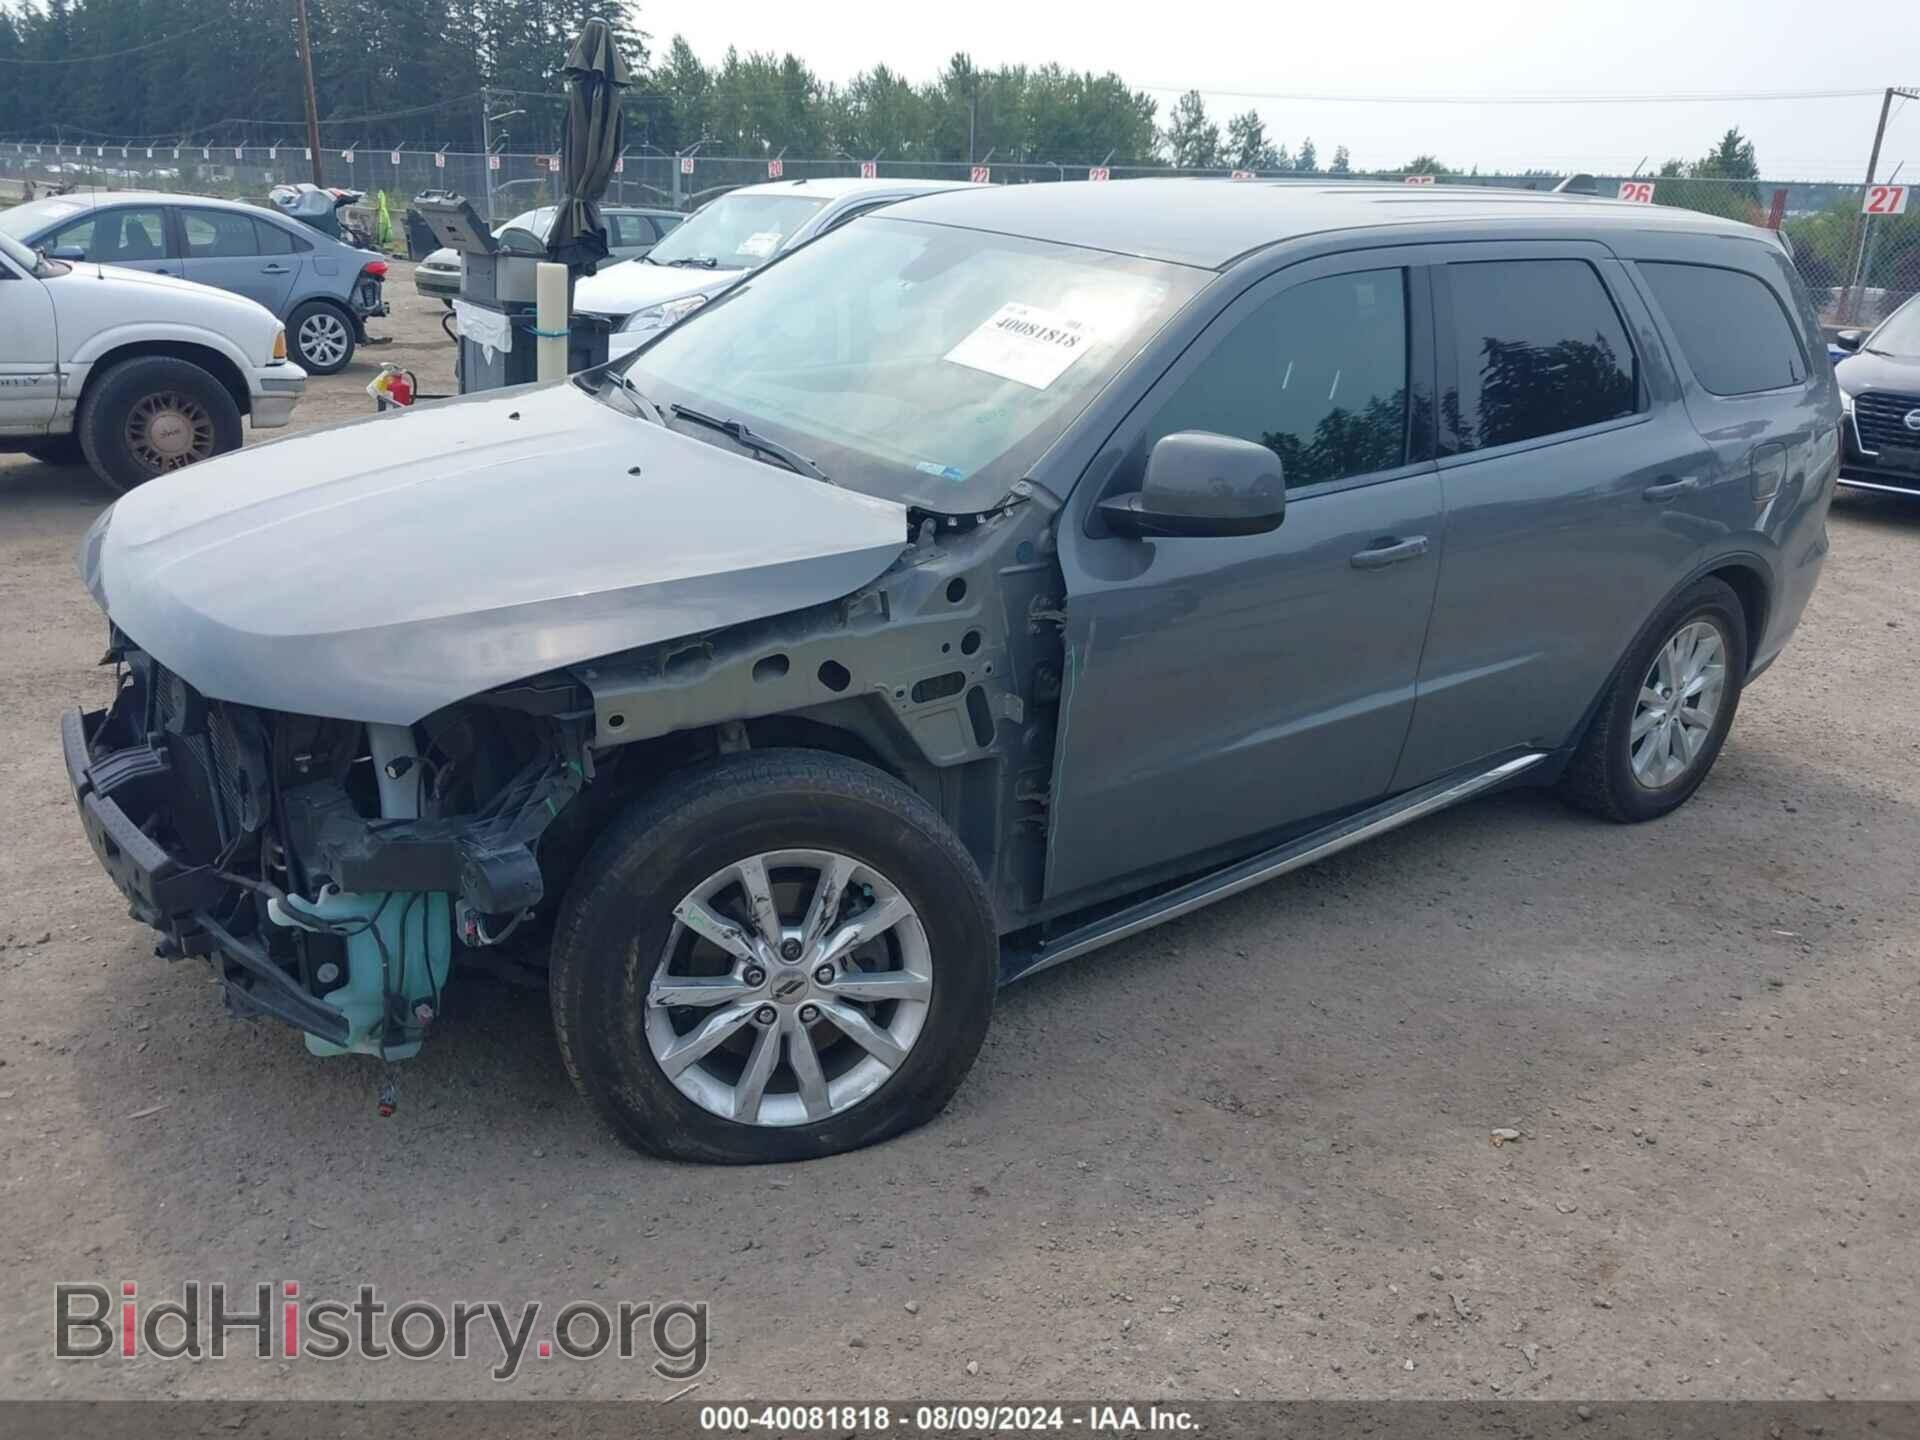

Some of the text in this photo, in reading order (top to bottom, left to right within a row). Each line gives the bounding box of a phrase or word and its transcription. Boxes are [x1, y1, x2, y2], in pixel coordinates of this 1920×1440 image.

[863, 163, 875, 178] 21
[973, 167, 988, 182] 22
[1623, 183, 1650, 202] 26
[1868, 187, 1904, 212] 27
[996, 317, 1080, 348] 40081818
